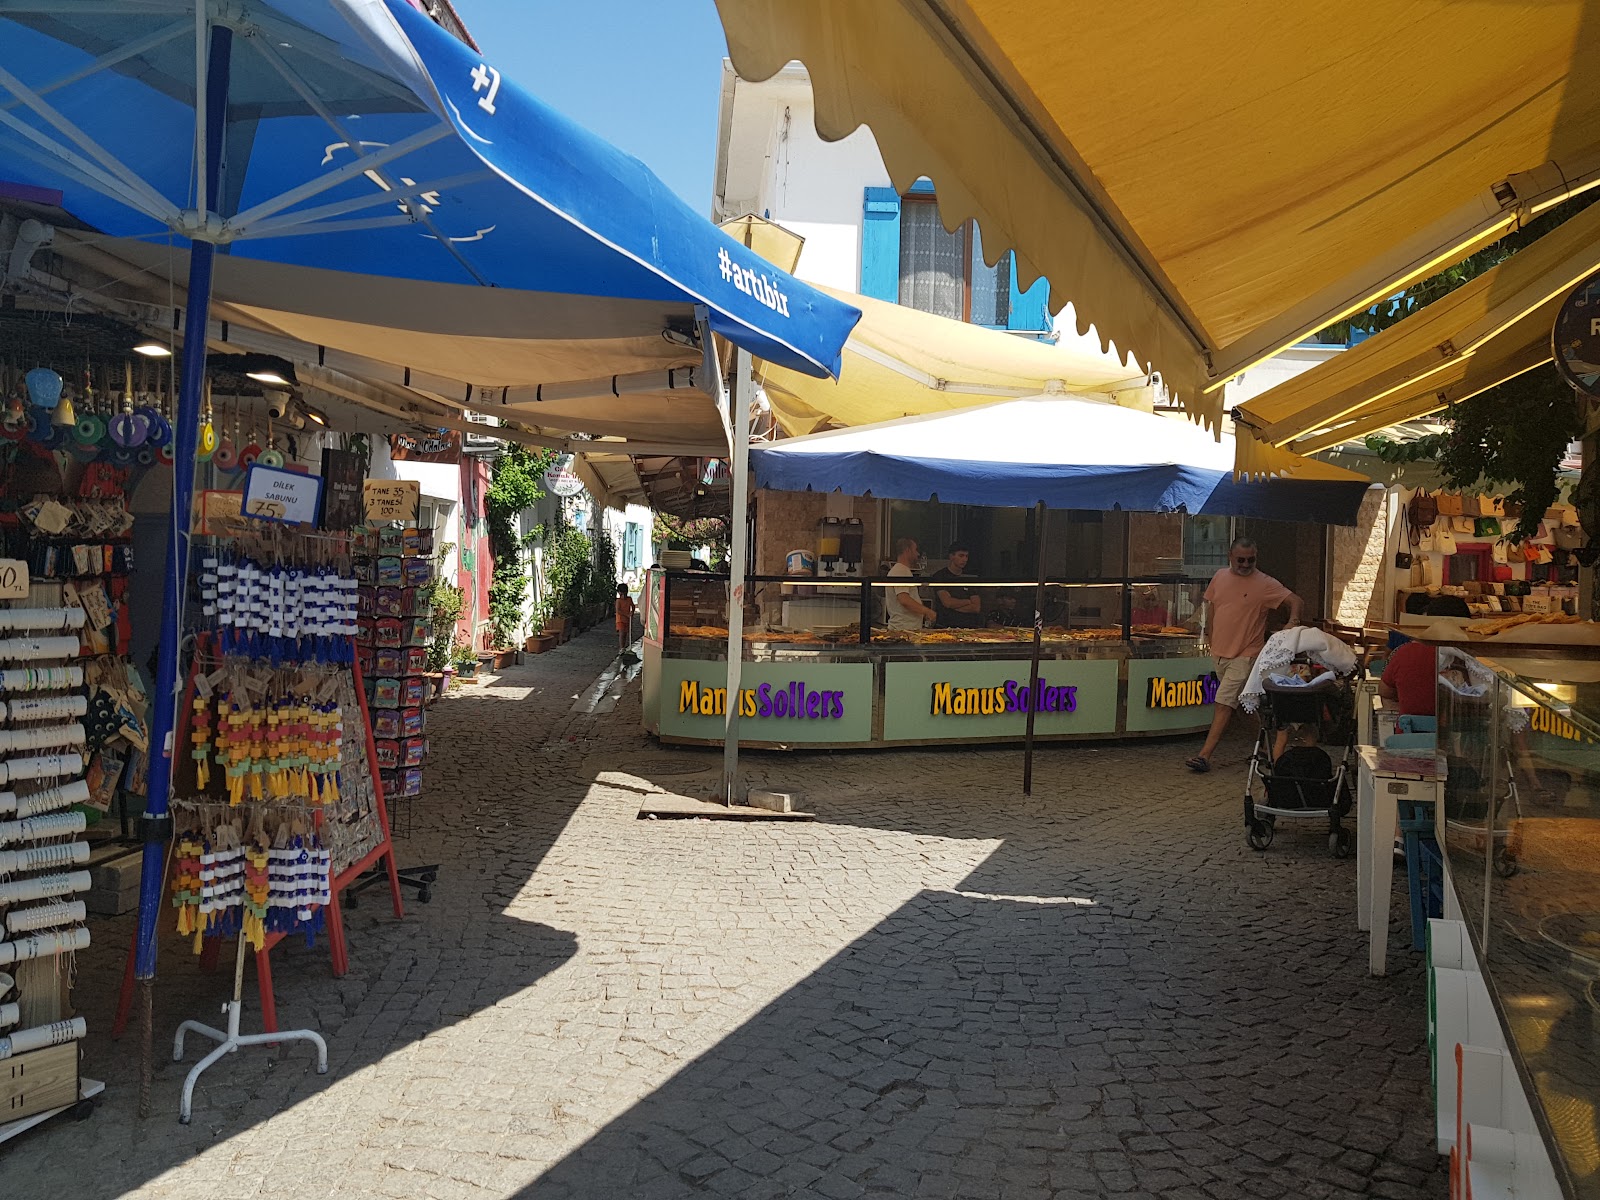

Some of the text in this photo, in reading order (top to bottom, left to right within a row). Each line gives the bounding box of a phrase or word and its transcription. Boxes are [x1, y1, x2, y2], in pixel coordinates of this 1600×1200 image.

[273, 481, 295, 491] DİLEK
[393, 487, 404, 497] 35
[265, 492, 298, 504] SABUNU
[369, 498, 375, 506] 3
[254, 501, 279, 518] 75
[380, 507, 394, 515] 100
[0, 566, 17, 589] 0
